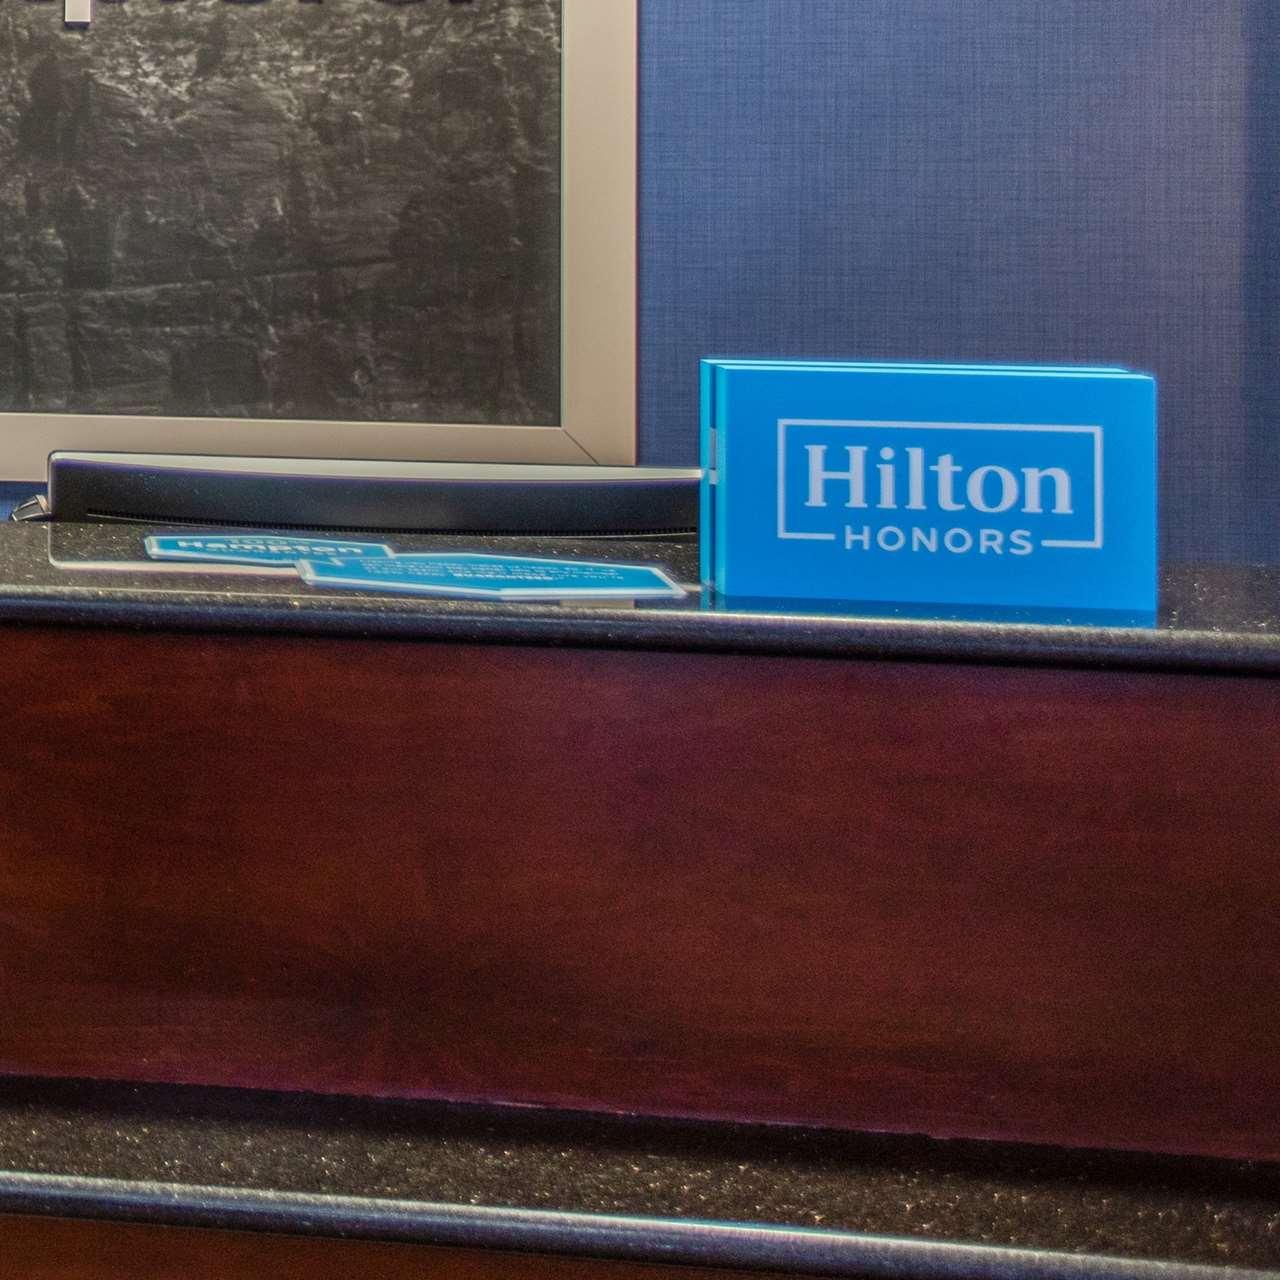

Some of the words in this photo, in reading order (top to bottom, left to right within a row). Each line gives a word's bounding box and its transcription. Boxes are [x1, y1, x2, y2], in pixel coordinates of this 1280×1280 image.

[803, 444, 1074, 515] Hilton
[177, 540, 363, 554] Hampton
[844, 524, 1034, 556] HONORS
